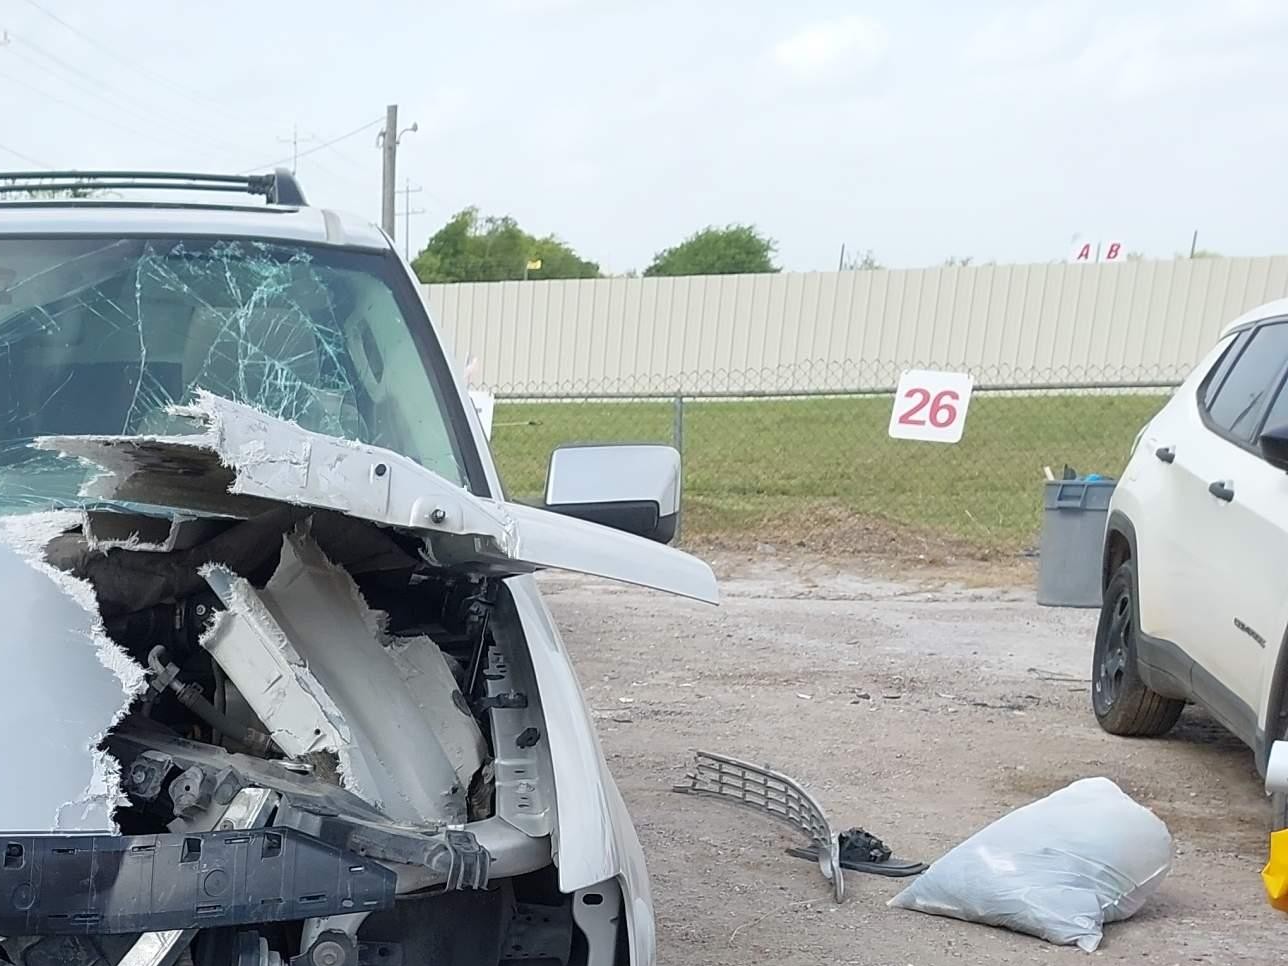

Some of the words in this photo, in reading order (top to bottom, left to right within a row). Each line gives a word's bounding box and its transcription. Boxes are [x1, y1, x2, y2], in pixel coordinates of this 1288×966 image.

[1077, 243, 1090, 260] A
[1107, 243, 1121, 260] B
[898, 387, 960, 428] 26
